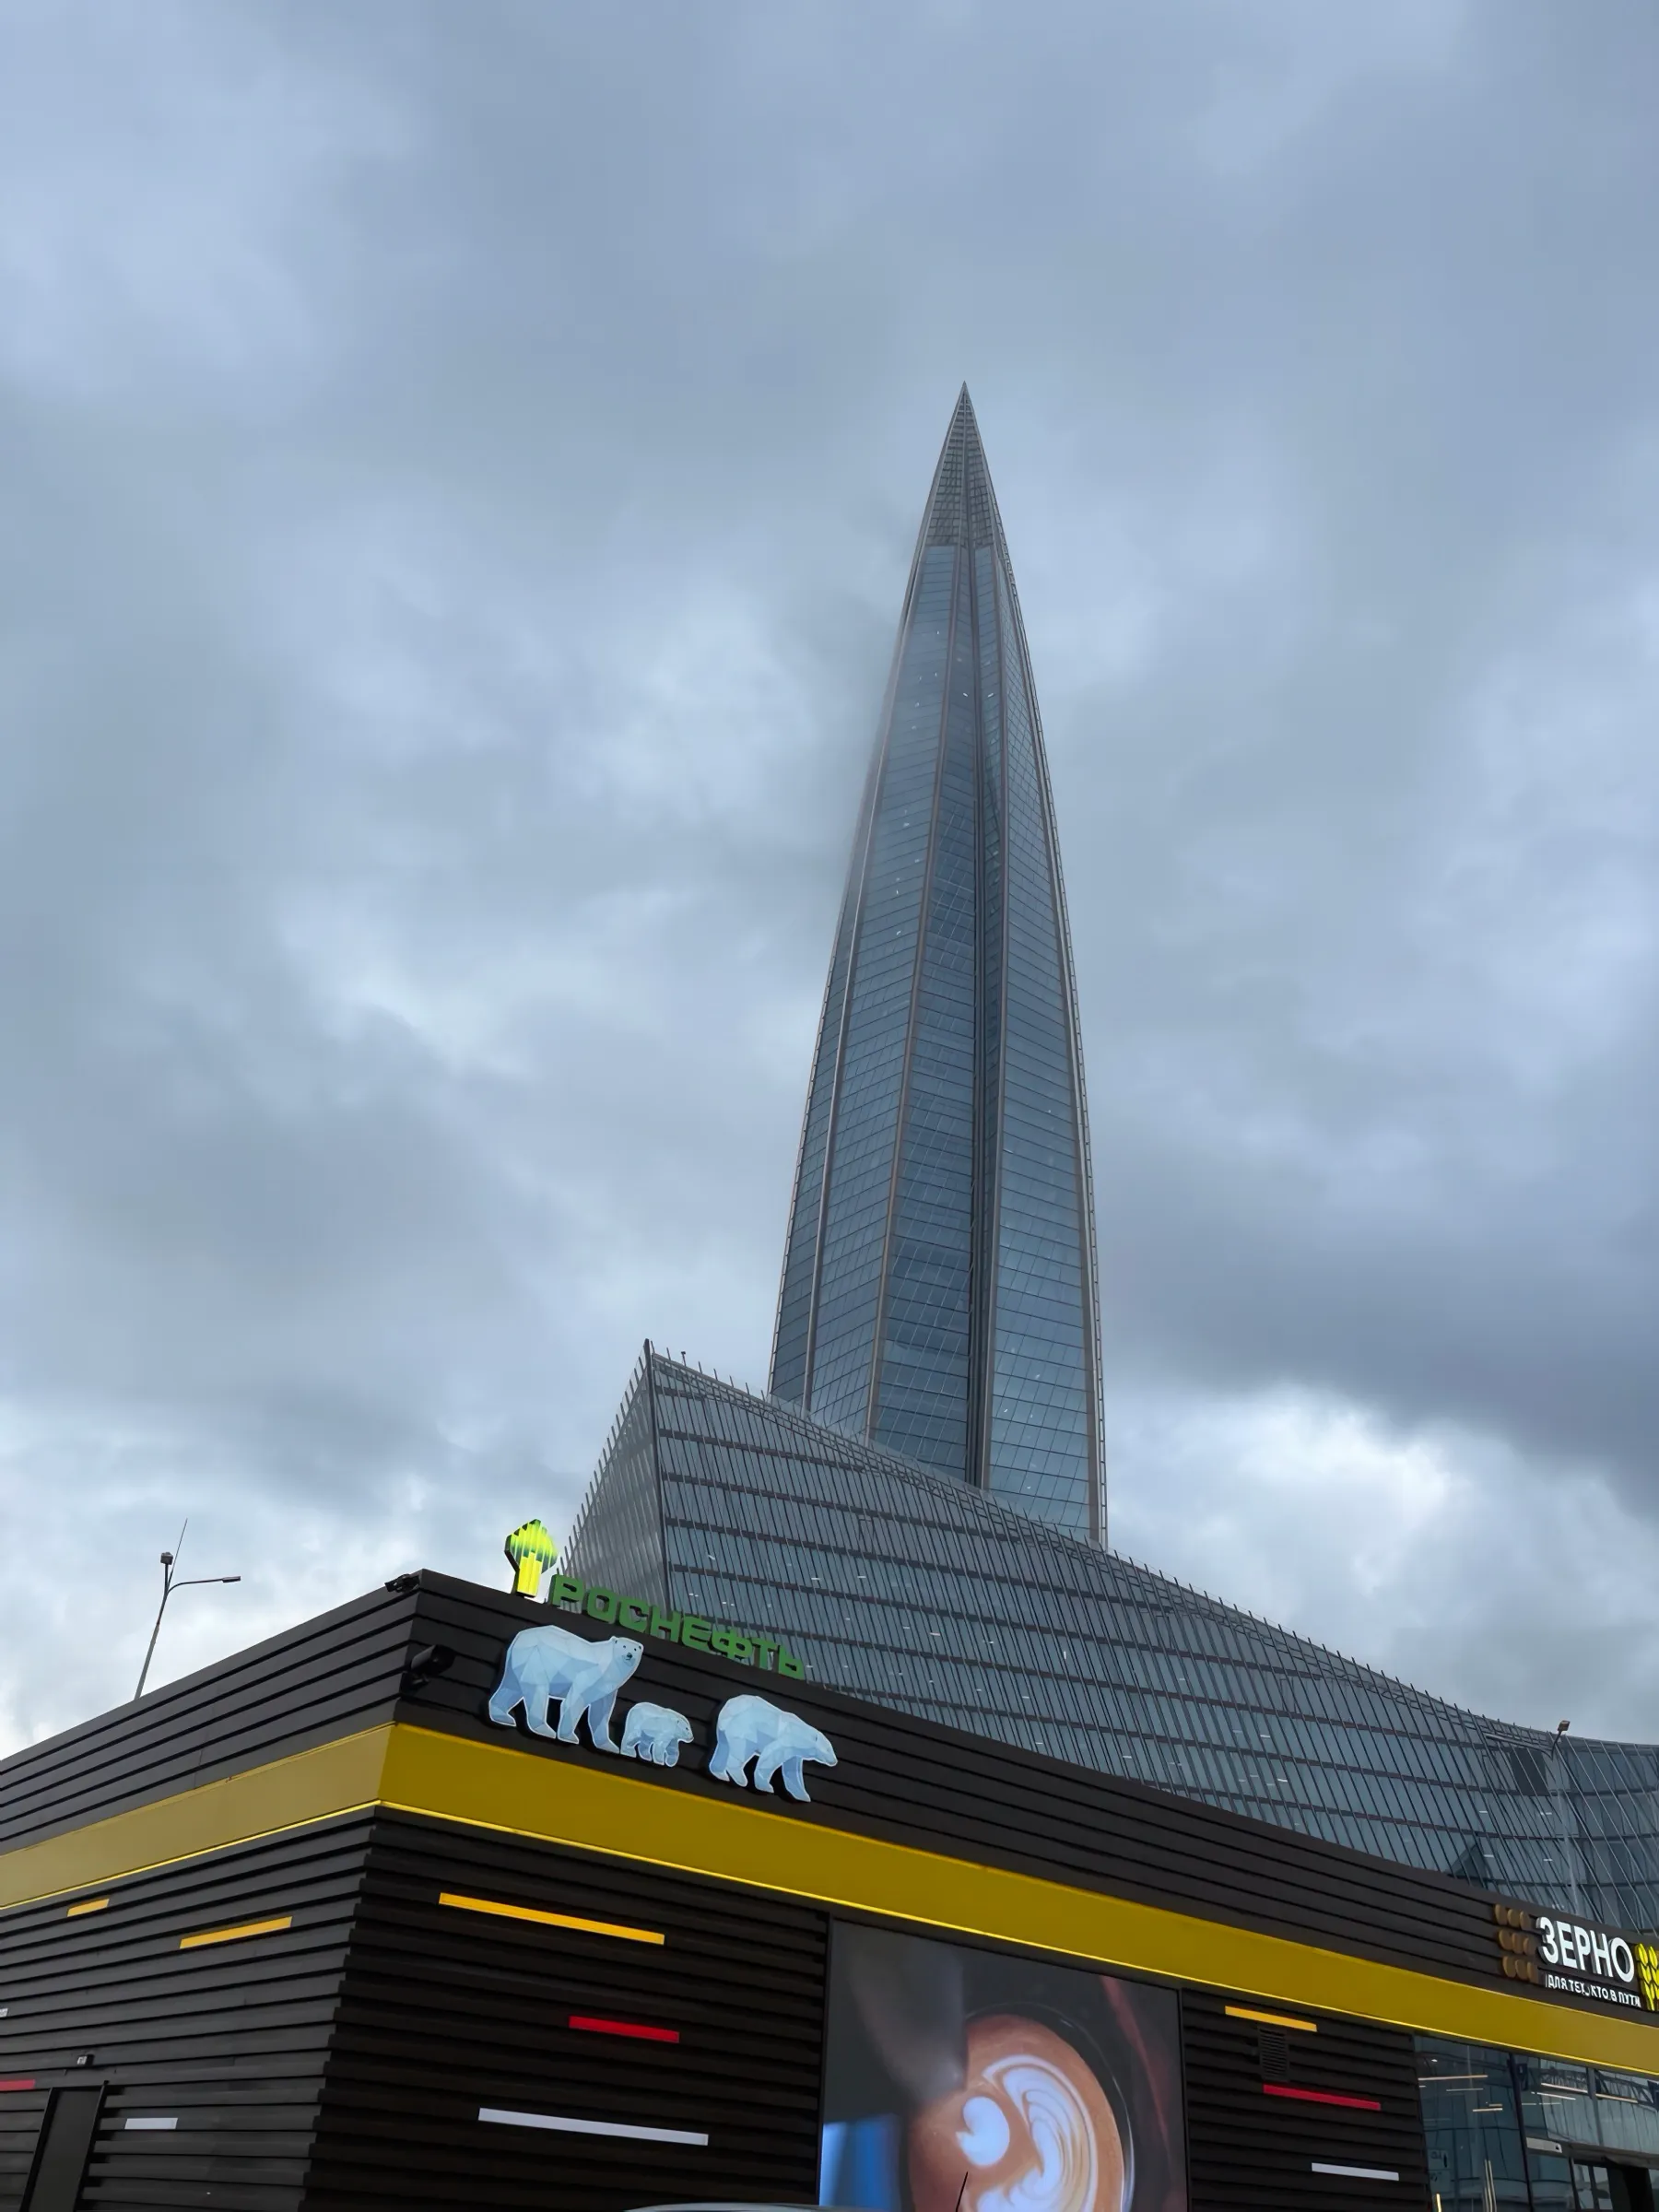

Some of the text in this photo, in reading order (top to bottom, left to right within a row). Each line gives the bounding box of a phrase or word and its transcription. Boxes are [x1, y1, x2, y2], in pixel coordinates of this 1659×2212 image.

[549, 1574, 805, 1680] РОСНЕФТЬ
[1536, 1916, 1634, 1983] ЗЕРНО
[1547, 1973, 1568, 1991] ДЛЯ
[1591, 1984, 1609, 2000] КТО
[1609, 1989, 1618, 2002] В
[1618, 1991, 1641, 2007] ПУТИ
